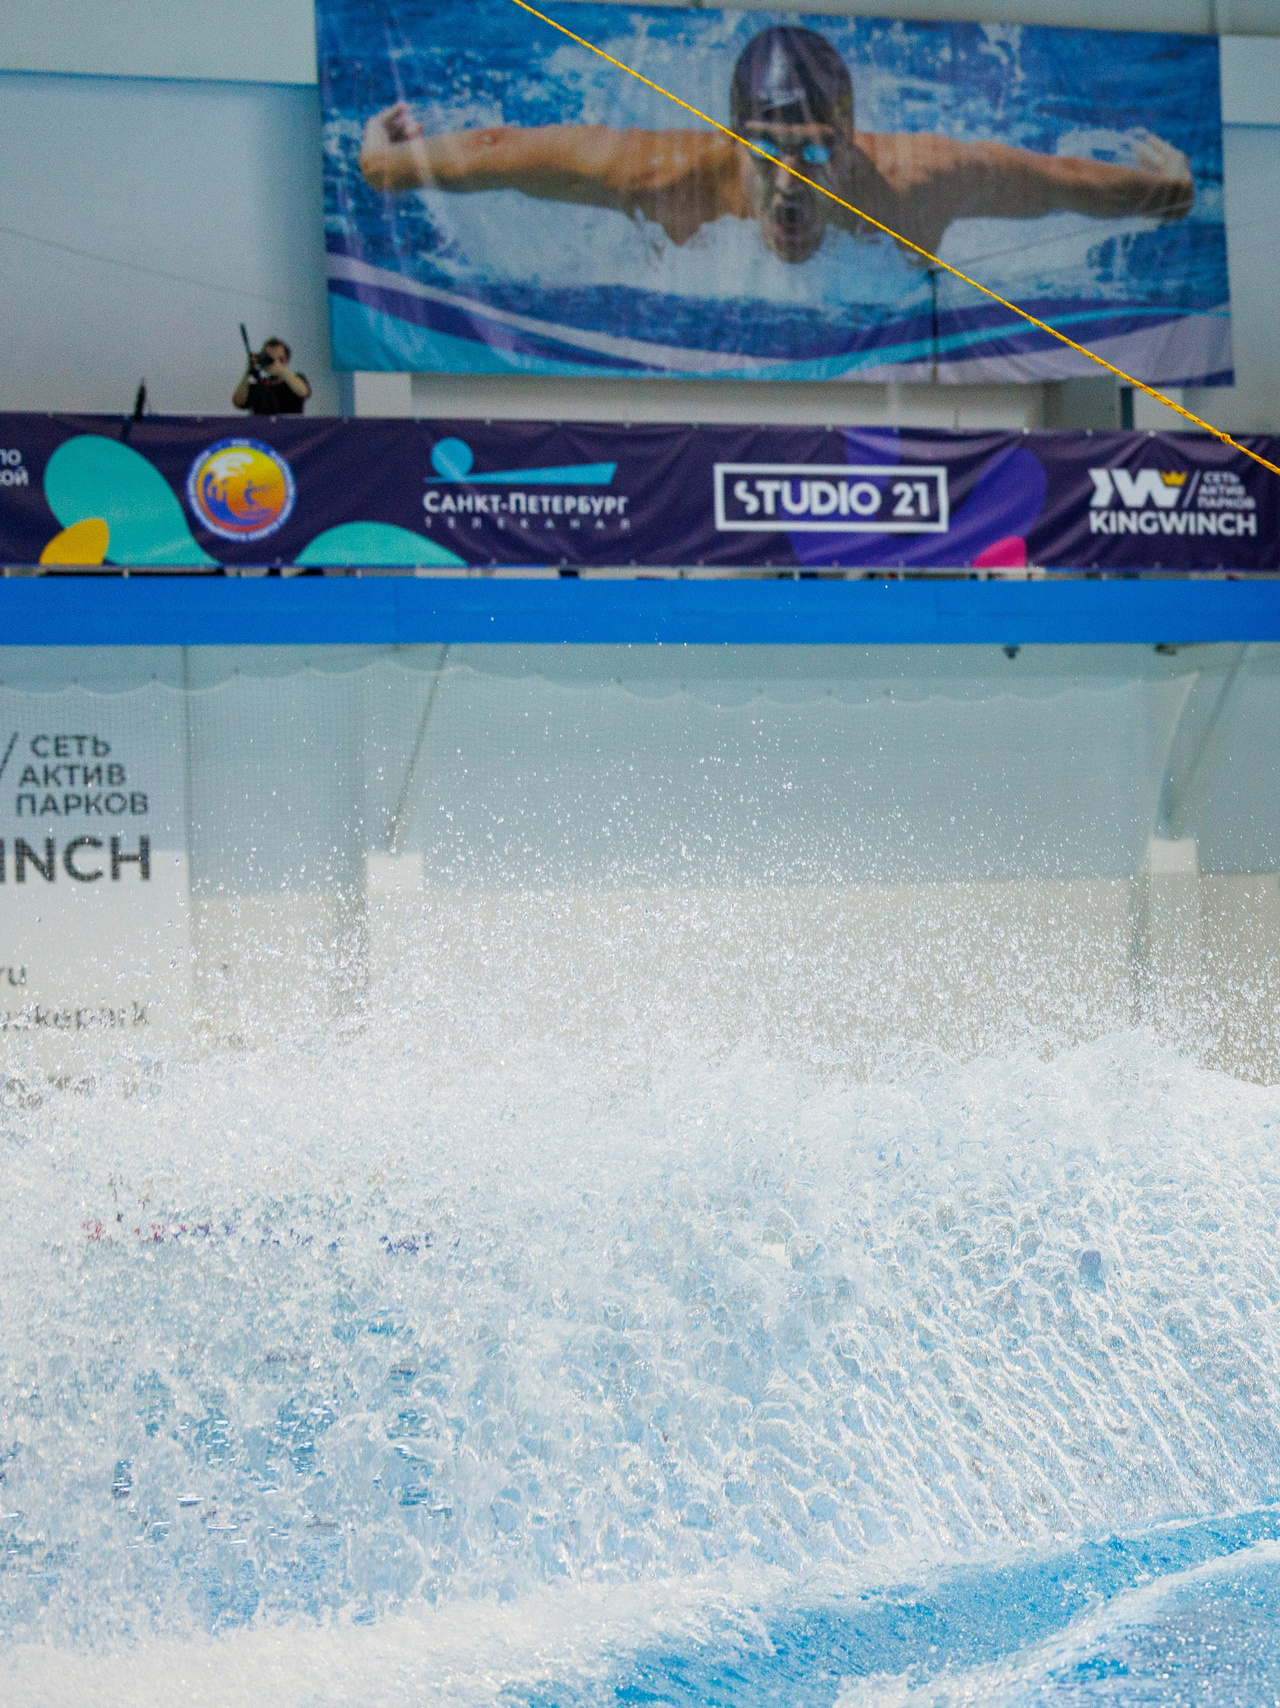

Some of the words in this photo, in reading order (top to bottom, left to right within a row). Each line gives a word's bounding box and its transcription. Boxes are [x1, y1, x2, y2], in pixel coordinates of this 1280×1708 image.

[733, 480, 882, 516] STUDIO
[892, 482, 930, 517] 21
[1089, 510, 1258, 537] KINGWINCH
[30, 734, 112, 759] СЕТЬ
[18, 762, 127, 788] АКТИВ
[15, 791, 149, 817] ПАРКОВ
[0, 966, 26, 986] u
